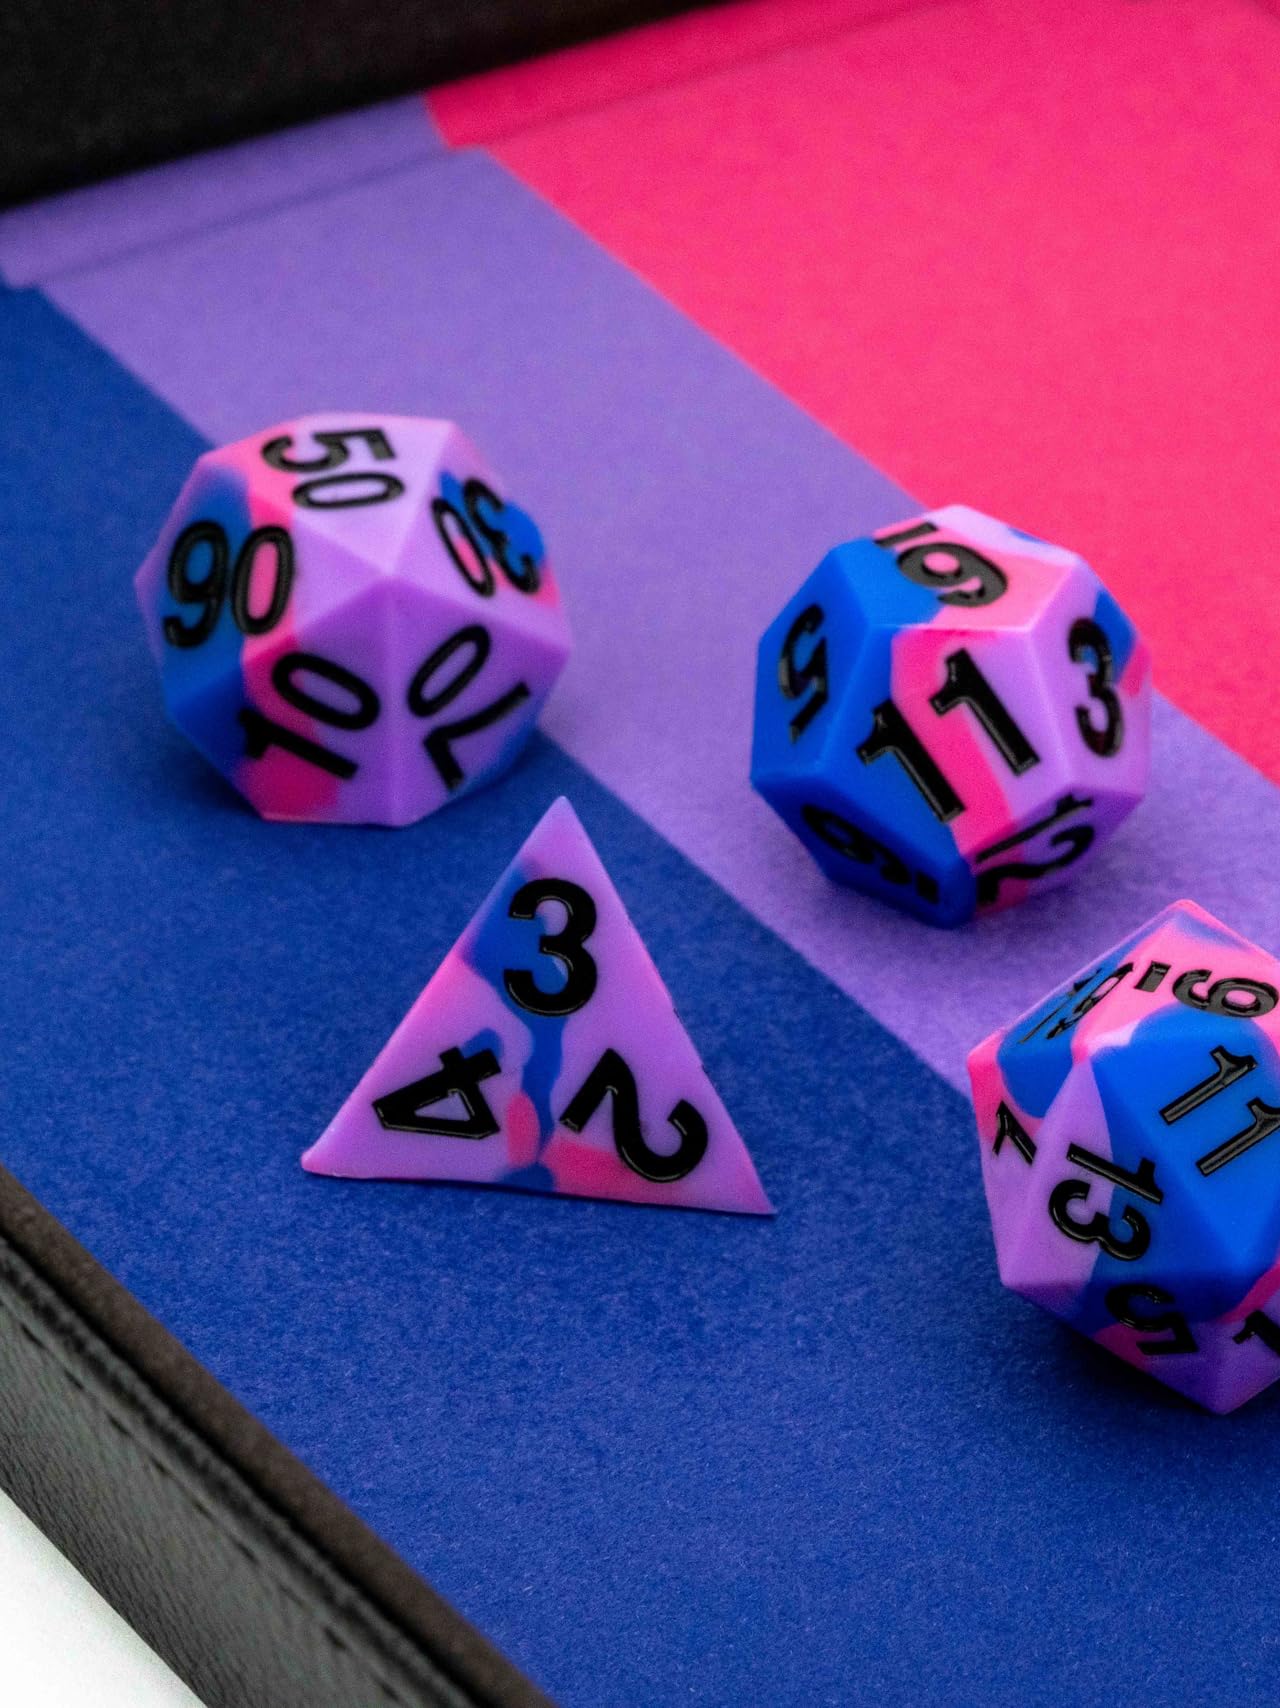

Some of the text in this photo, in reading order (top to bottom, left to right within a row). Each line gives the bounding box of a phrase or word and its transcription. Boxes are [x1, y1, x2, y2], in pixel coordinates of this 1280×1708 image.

[262, 429, 405, 510] 50
[163, 520, 295, 649] 90
[430, 478, 541, 598] 30
[239, 652, 381, 780] 10
[407, 625, 531, 791] 70
[778, 604, 829, 744] 5
[856, 648, 1041, 823] 11
[1067, 617, 1126, 757] 3
[974, 793, 1095, 906] 12
[503, 878, 598, 1016] 3
[371, 1046, 502, 1140] 4
[559, 1048, 709, 1183] 2
[1048, 1143, 1163, 1262] 13
[1104, 1283, 1198, 1355] 5
